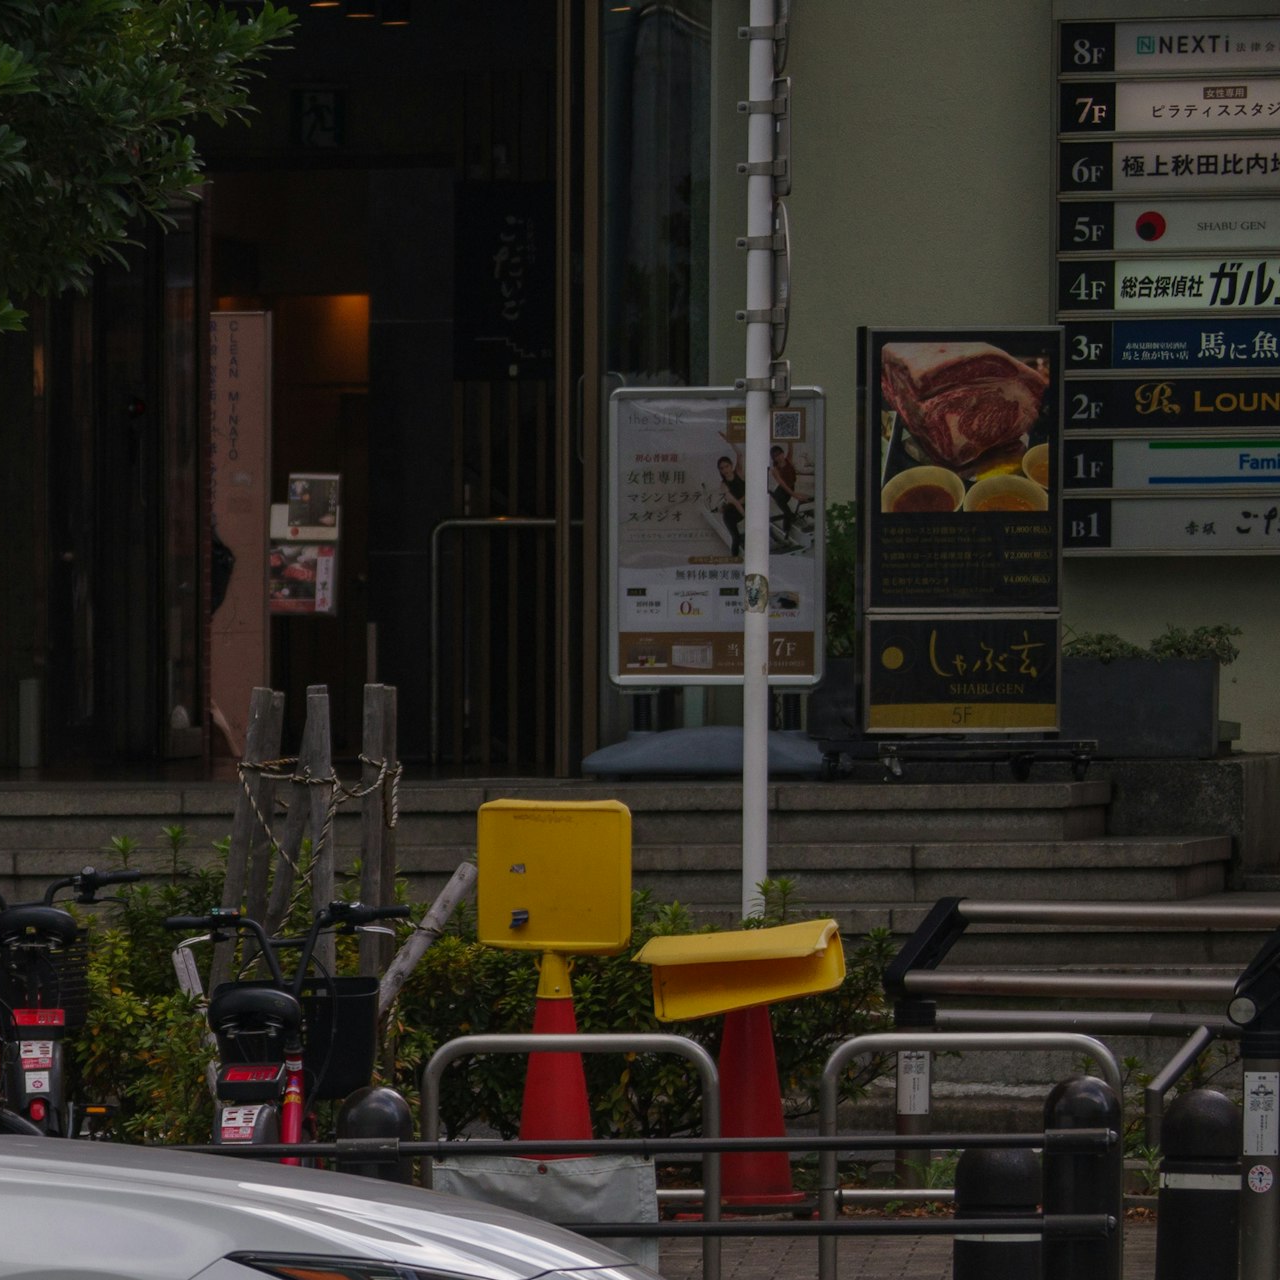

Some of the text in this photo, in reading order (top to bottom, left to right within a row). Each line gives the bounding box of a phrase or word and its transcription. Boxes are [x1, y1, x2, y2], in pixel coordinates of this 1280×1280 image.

[1073, 39, 1105, 65] 8F
[1159, 35, 1230, 54] NEXTi
[1236, 41, 1280, 53] 法律会
[1205, 88, 1246, 99] 女性専用
[1074, 97, 1107, 124] 7F
[1071, 156, 1104, 183] 6F
[1073, 216, 1105, 243] 5F
[1197, 221, 1266, 231] SHABU GEN
[1069, 272, 1106, 301] 4F
[1121, 261, 1280, 306] 総合探偵社 ガル
[1071, 335, 1103, 361] 3F
[228, 320, 239, 461] CLEAN MINATO
[1071, 393, 1104, 420] 2F
[626, 470, 685, 485] 女性専用
[1073, 452, 1104, 479] 1F
[626, 511, 683, 522] スタジオ
[1071, 511, 1101, 538] B1
[1185, 520, 1216, 536] 赤坂
[773, 637, 797, 657] 7F
[928, 628, 1046, 678] しゃぶ玄
[949, 681, 1025, 696] SHABUGEN
[951, 706, 973, 725] 5F
